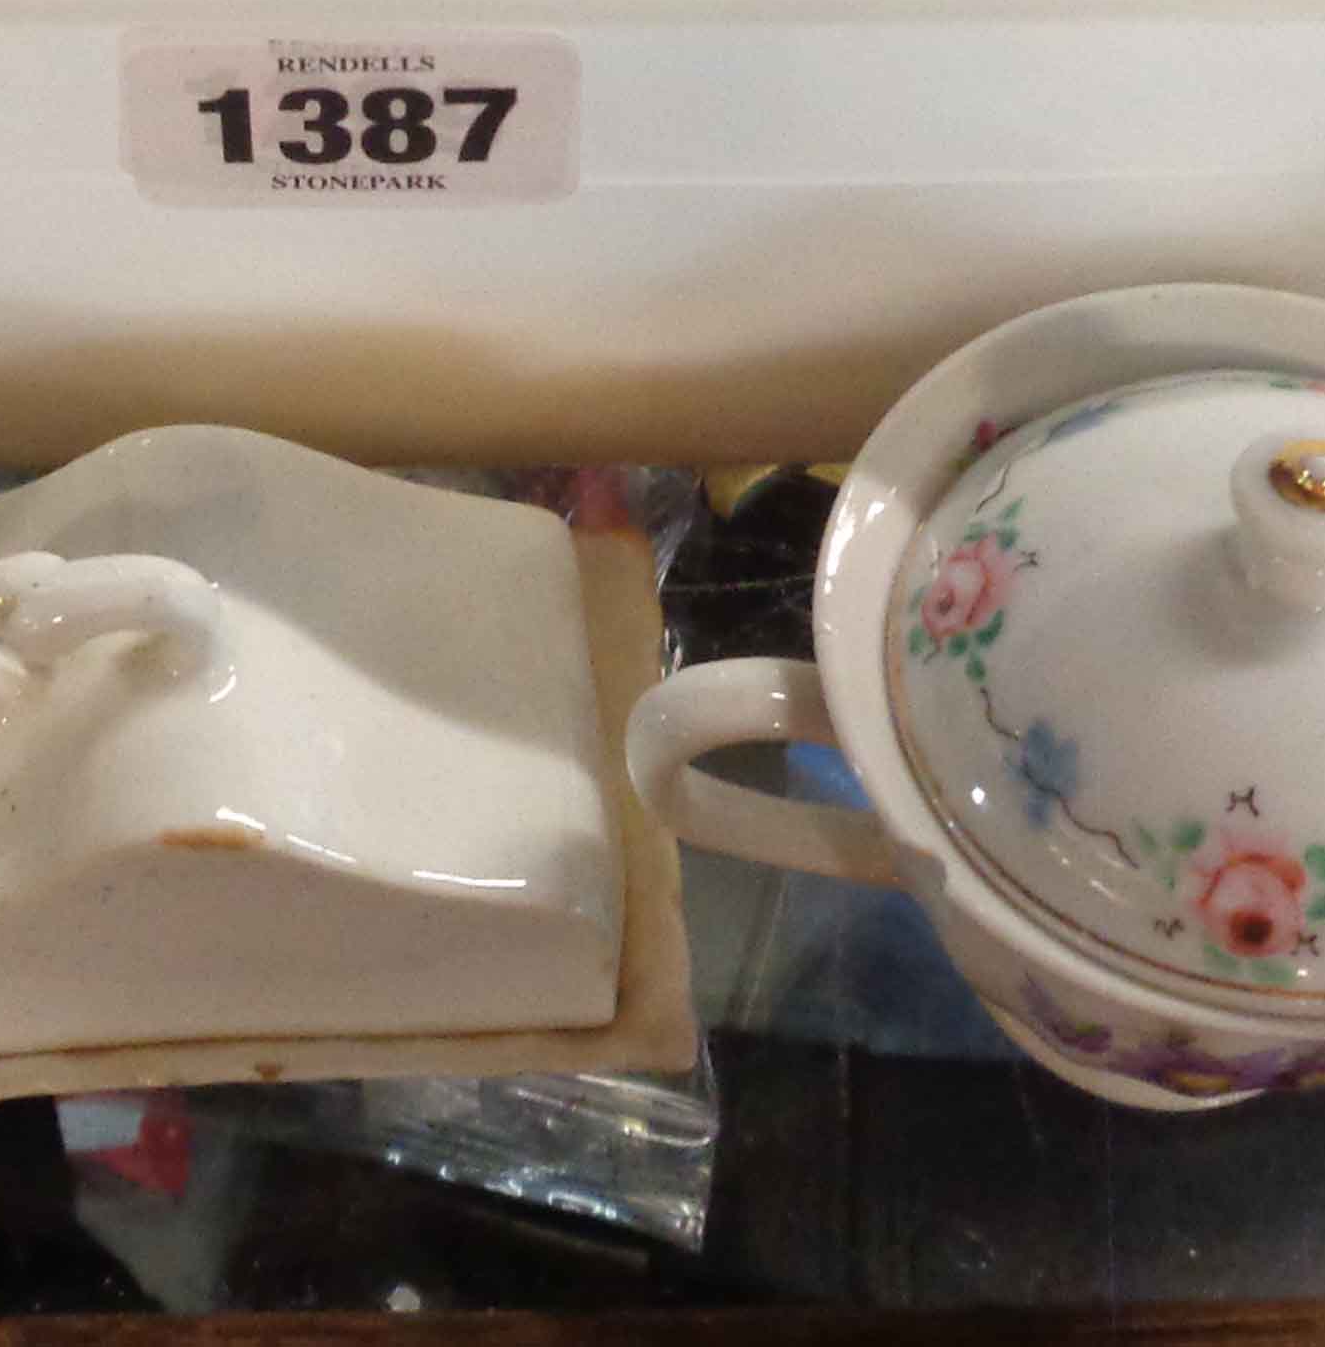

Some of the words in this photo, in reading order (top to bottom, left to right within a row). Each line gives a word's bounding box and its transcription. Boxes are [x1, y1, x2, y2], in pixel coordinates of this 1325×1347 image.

[277, 55, 436, 74] RENDELLS
[198, 87, 518, 165] 1387
[270, 174, 448, 191] STONEPARK
